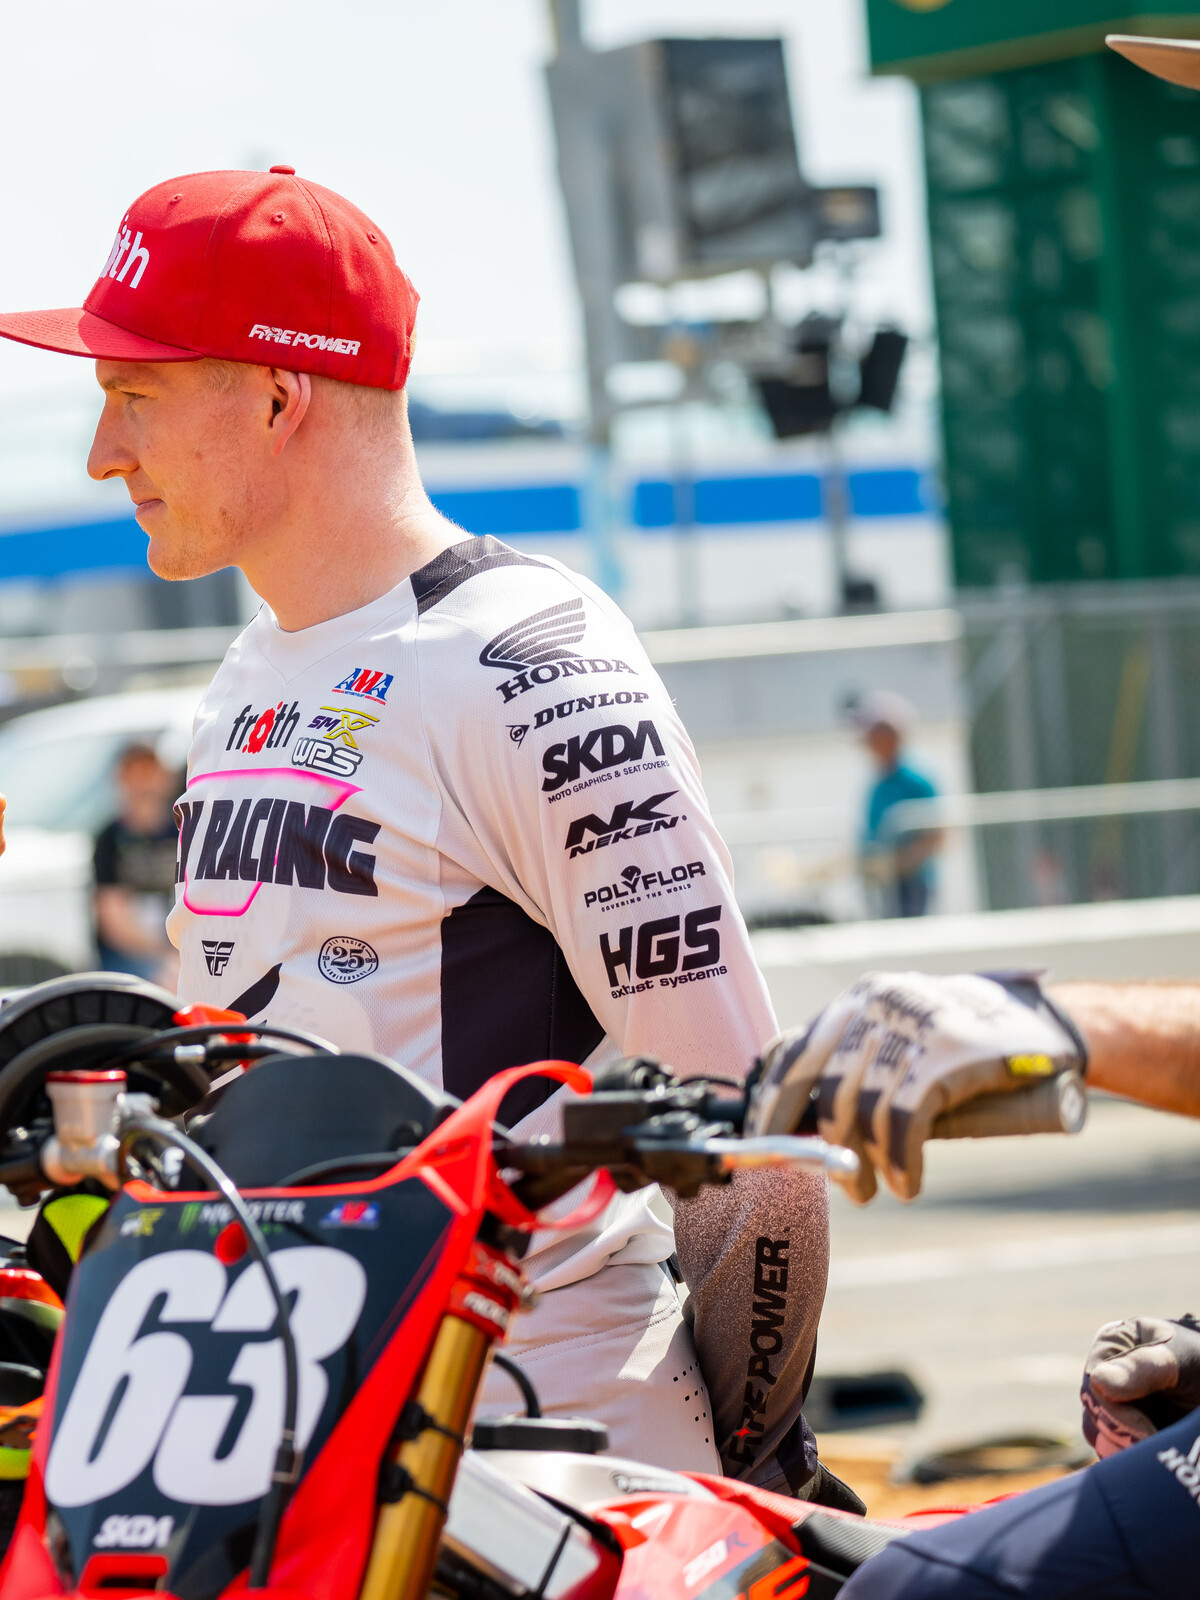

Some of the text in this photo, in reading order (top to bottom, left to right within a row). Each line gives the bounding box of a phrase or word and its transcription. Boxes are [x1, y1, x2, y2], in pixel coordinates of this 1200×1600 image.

[334, 667, 394, 701] AMA
[496, 659, 639, 704] HONDA
[226, 701, 300, 754] froth
[534, 692, 649, 730] DUNLOP
[292, 737, 364, 778] WPS
[541, 719, 666, 792] SKDA
[547, 760, 671, 804] MOTO GRAPHICS & SEAT COVERS
[194, 797, 382, 897] RACING
[569, 815, 680, 860] NEKEN
[584, 861, 706, 908] POLYFLOR
[601, 883, 692, 912] COVERING THE WORLD
[330, 946, 365, 969] 25
[599, 904, 722, 988] HGS
[659, 965, 728, 988] systems
[747, 1236, 790, 1386] POWER
[44, 1245, 368, 1508] 63
